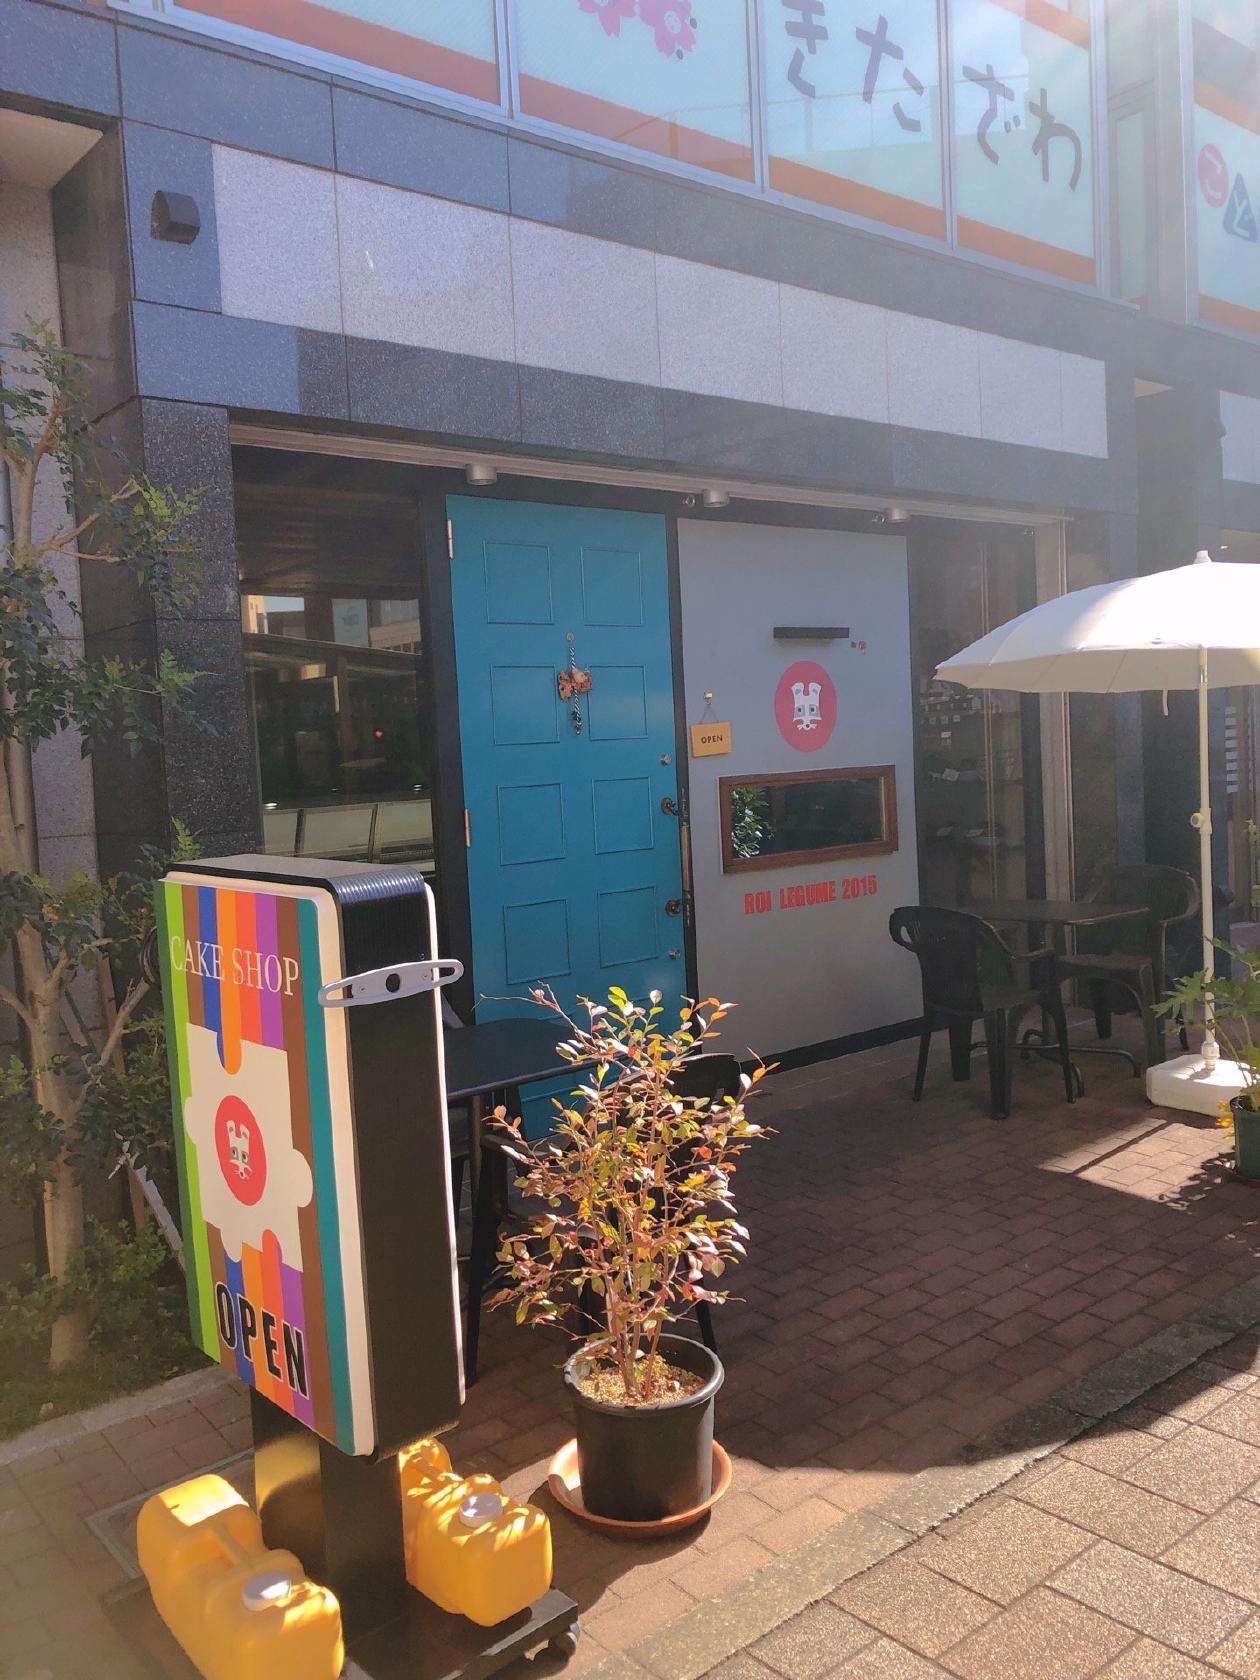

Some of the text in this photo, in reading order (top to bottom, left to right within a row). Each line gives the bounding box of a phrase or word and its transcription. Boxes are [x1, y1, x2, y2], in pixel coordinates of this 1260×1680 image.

[782, 0, 1082, 192] きたざわ
[701, 735, 723, 744] OPEN
[744, 891, 772, 915] ROI
[842, 875, 878, 899] 2015
[170, 935, 299, 996] CAKE SHOP
[215, 1281, 309, 1400] OPEN
